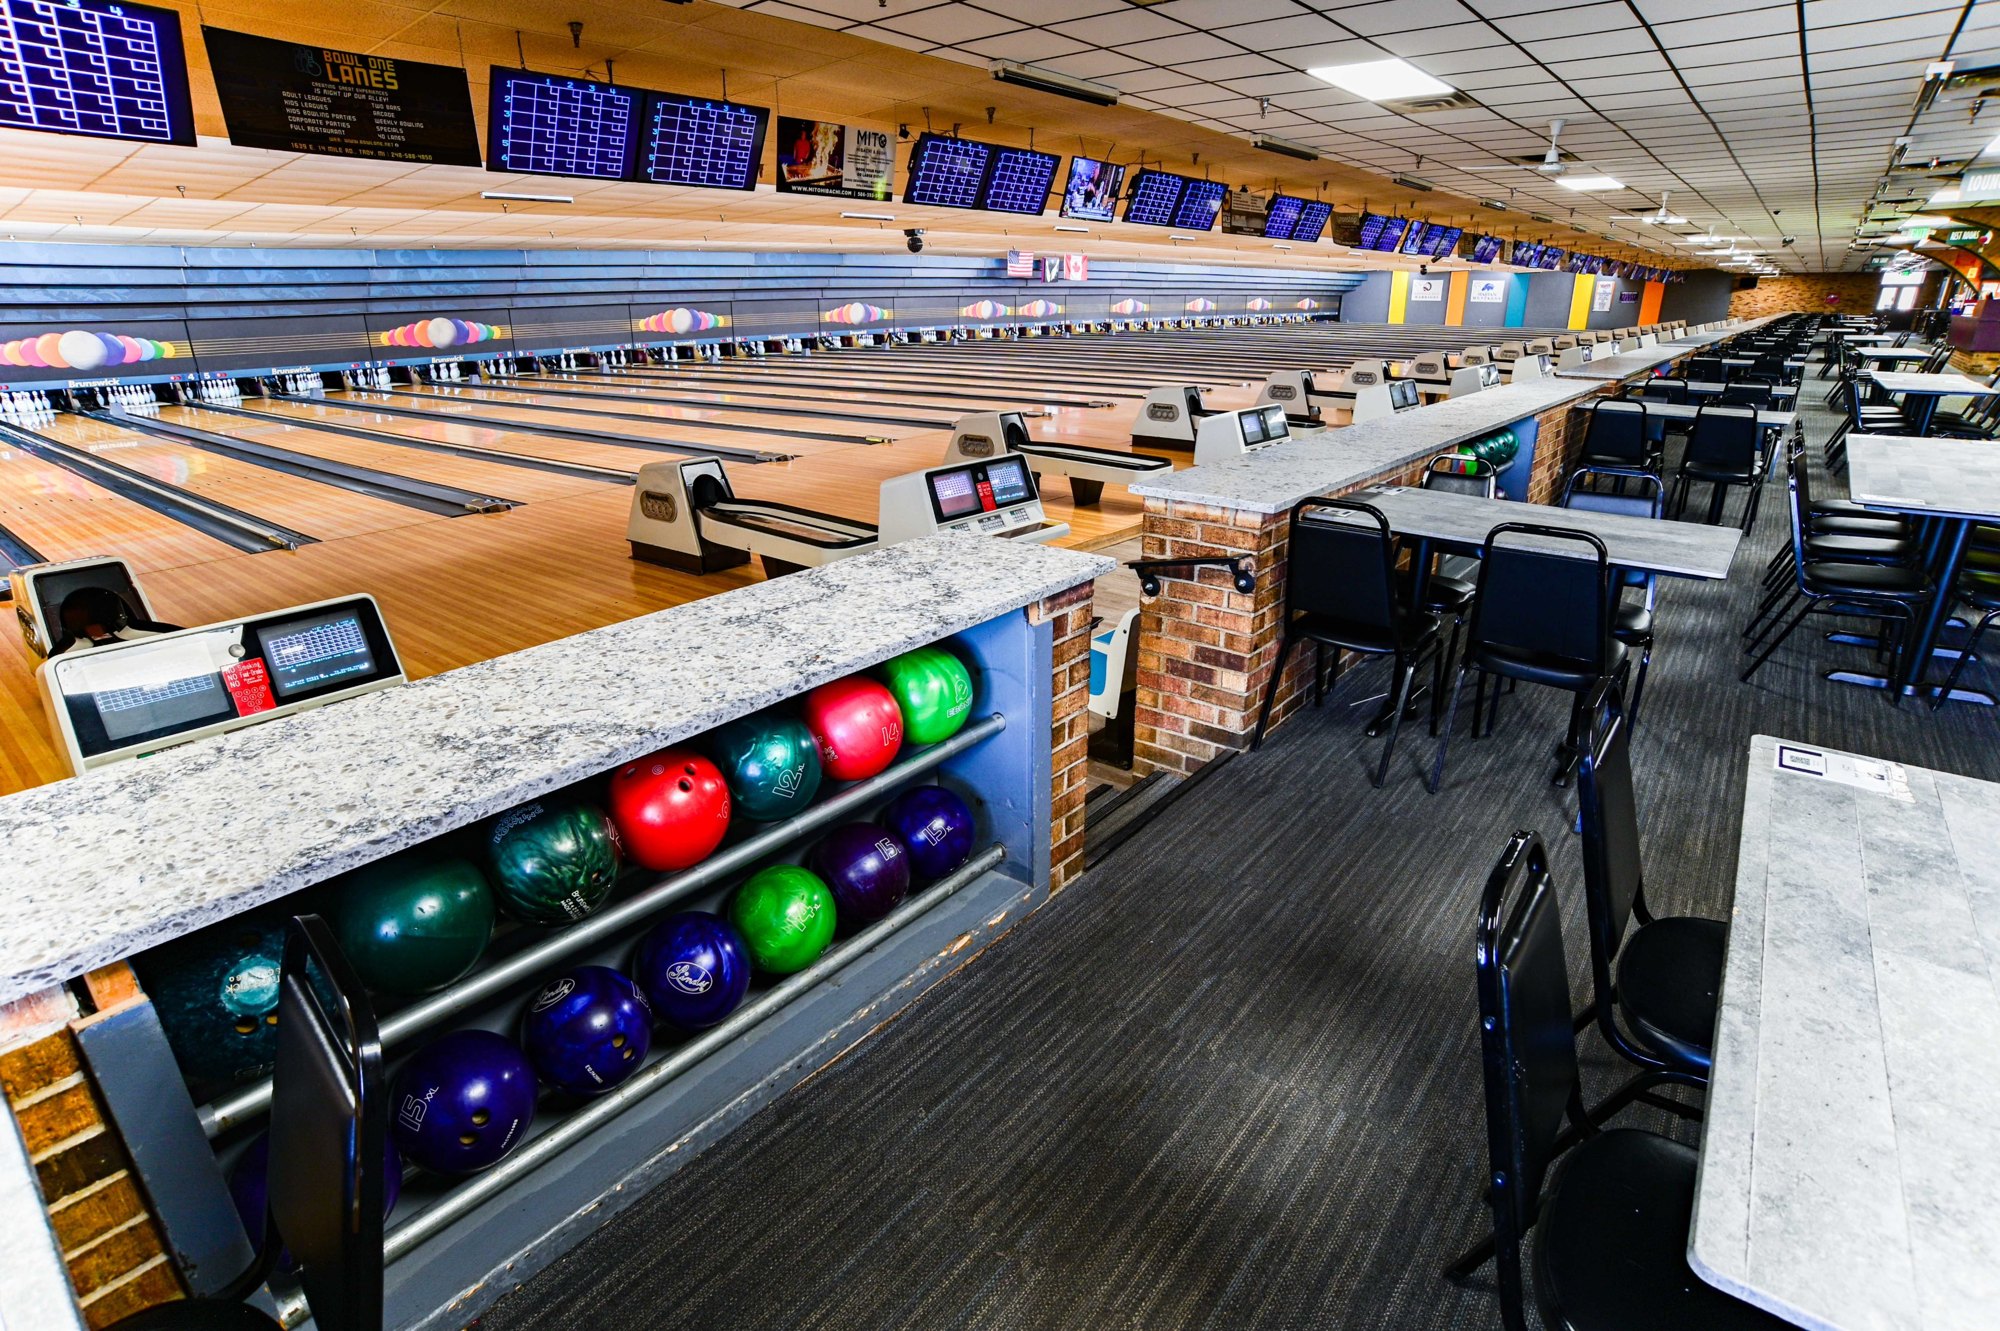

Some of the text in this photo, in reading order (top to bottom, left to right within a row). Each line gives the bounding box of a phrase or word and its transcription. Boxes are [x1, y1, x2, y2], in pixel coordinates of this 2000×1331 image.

[110, 6, 124, 16] 4
[323, 50, 395, 72] BOWL ONE
[326, 63, 398, 90] LANES
[301, 102, 328, 111] LEAGUES
[304, 94, 332, 103] LEAGUES
[288, 116, 351, 129] CORPORATE PARTIES
[303, 110, 330, 119] BOWLING
[332, 113, 357, 122] PARTIES
[307, 125, 346, 135] RESTAURANT
[857, 130, 887, 148] MITO
[792, 185, 852, 195] WWW.MITOHIBACHI.COM
[1967, 173, 2000, 192] LOUN
[432, 355, 464, 363] Brunswick
[272, 366, 312, 375] Brunswick
[69, 378, 120, 388] Brunswick
[947, 695, 973, 718] EBON
[882, 723, 898, 746] 14
[772, 769, 801, 798] 12
[493, 808, 544, 843] BOWLING
[922, 820, 946, 846] 15
[875, 838, 898, 861] 15
[669, 964, 710, 992] Lindy
[399, 1094, 427, 1132] 15
